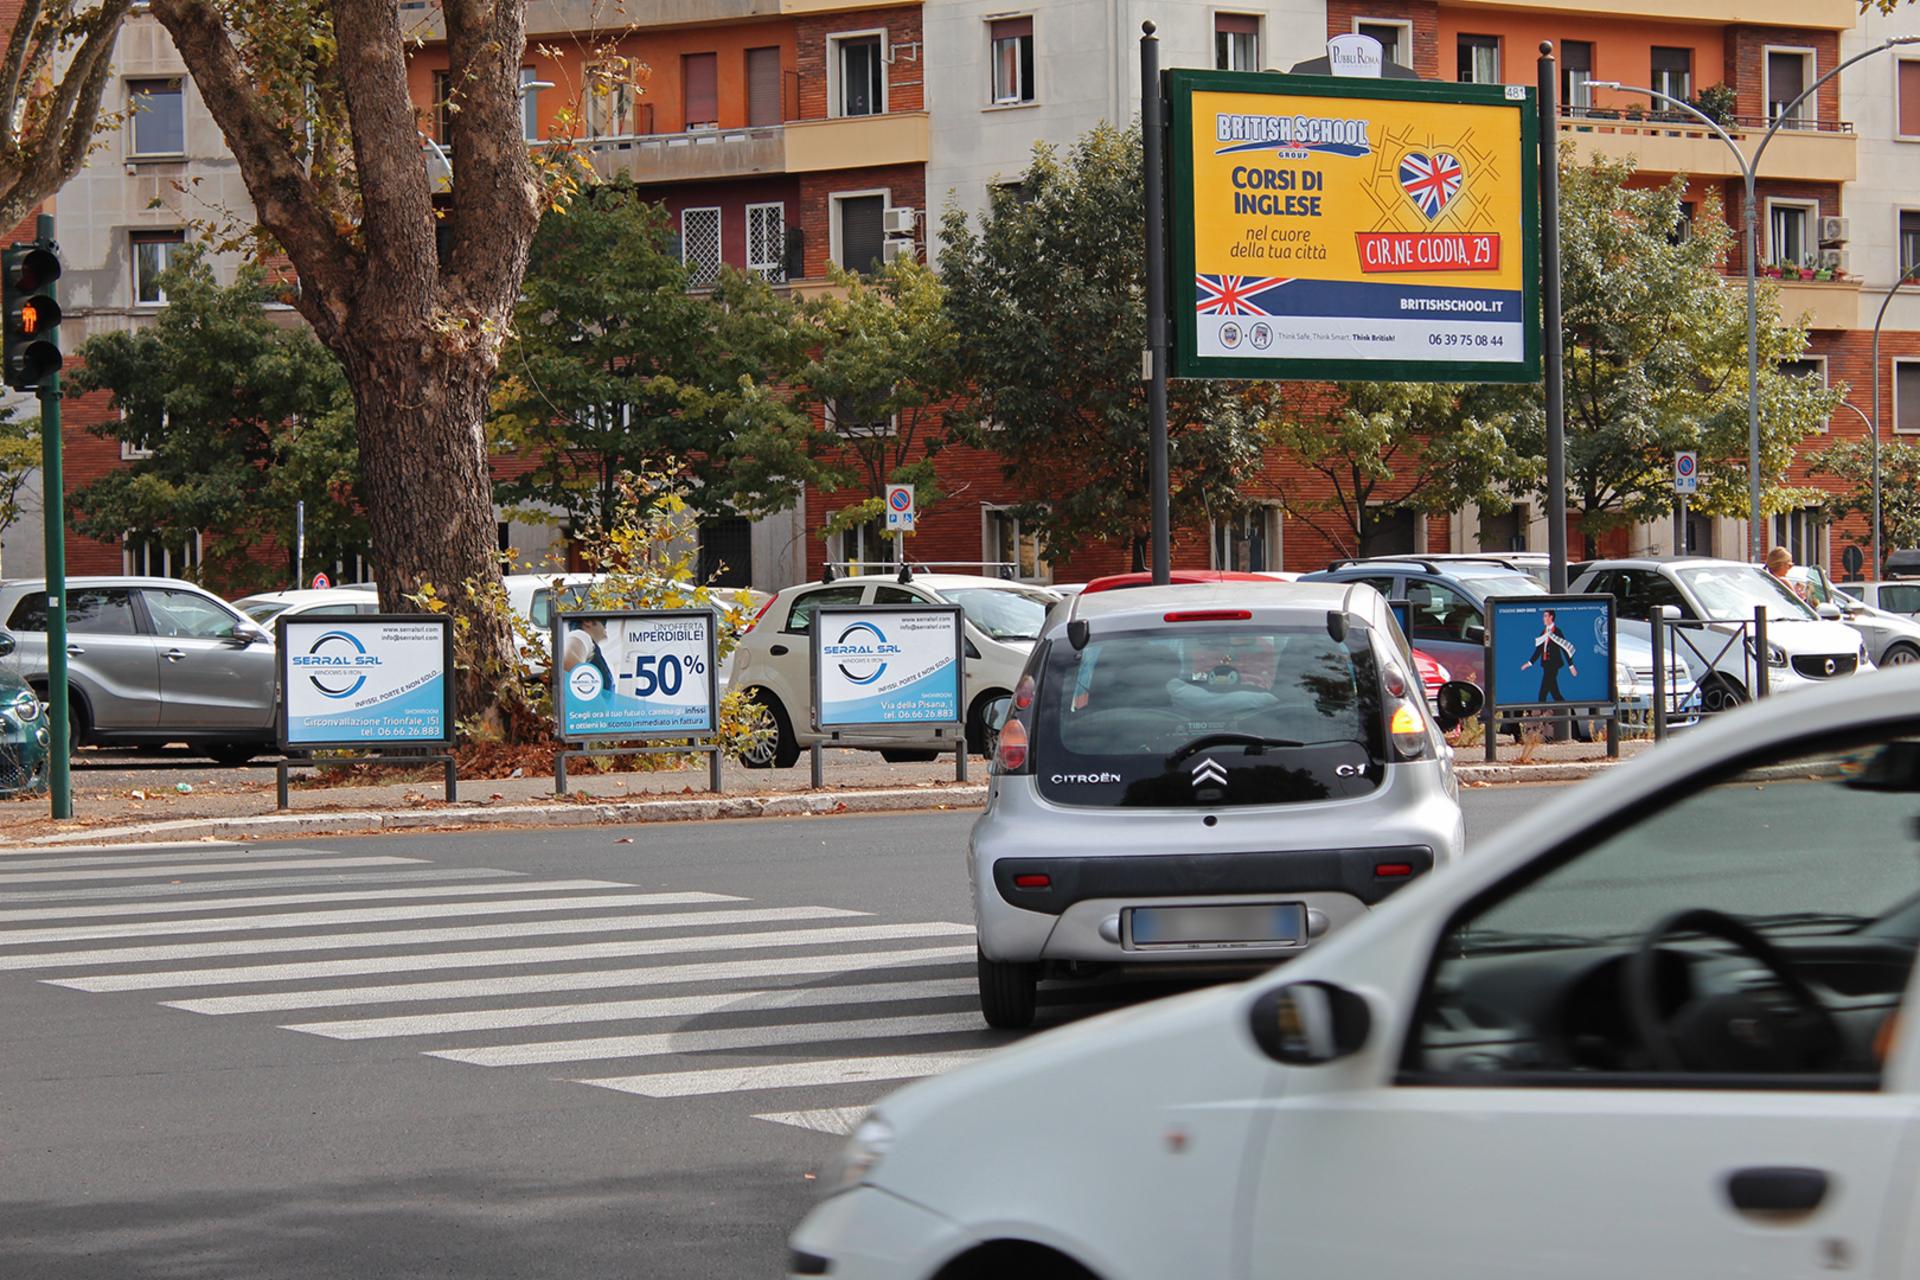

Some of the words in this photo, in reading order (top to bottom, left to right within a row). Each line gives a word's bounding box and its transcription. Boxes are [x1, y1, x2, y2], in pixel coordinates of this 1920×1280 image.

[1507, 87, 1525, 98] 481
[1216, 114, 1292, 141] BRITISH
[1294, 115, 1367, 145] SCHOOL
[1279, 151, 1309, 159] GROUP
[1232, 166, 1296, 190] CORSI
[1302, 171, 1322, 191] DI
[1234, 192, 1322, 216] INGLESE
[1246, 225, 1267, 241] nel
[1271, 229, 1311, 242] cuore
[1230, 242, 1264, 258] della
[1268, 244, 1292, 259] tua
[1295, 243, 1327, 260] città
[1366, 239, 1413, 265] CIR.NE
[1418, 238, 1471, 266] CLODIA,
[1473, 237, 1491, 263] 29
[1400, 298, 1504, 313] BRITISHSCHOOL.IT
[1278, 332, 1294, 340] Think
[1313, 333, 1330, 341] Think
[1372, 334, 1396, 342] British!
[1428, 334, 1442, 345] 06
[1444, 334, 1458, 346] 39
[1461, 335, 1473, 346] 75
[1475, 335, 1489, 346] 08
[1490, 335, 1504, 347] 44
[654, 623, 704, 631] UN'OFFERTA
[381, 634, 439, 642] info@serralsrl.com
[629, 631, 704, 643] IMPERDIBILE!
[824, 645, 874, 654] SERRAL
[877, 645, 901, 653] SRL
[292, 656, 351, 665] SERRAL
[355, 656, 383, 665] SRL
[619, 654, 705, 697] -50%
[899, 675, 917, 686] PORTE
[921, 666, 935, 675] NON
[380, 689, 400, 700] PORTE
[405, 680, 420, 690] NON
[881, 701, 895, 709] Via
[897, 700, 916, 709] della
[918, 700, 947, 709] Pisana,
[569, 711, 590, 720] Scegli
[304, 717, 380, 728] Circonvallazione
[427, 716, 439, 725] 151
[632, 719, 671, 727] immediato
[1336, 763, 1366, 776] C1
[1051, 772, 1120, 784] CITROËN
